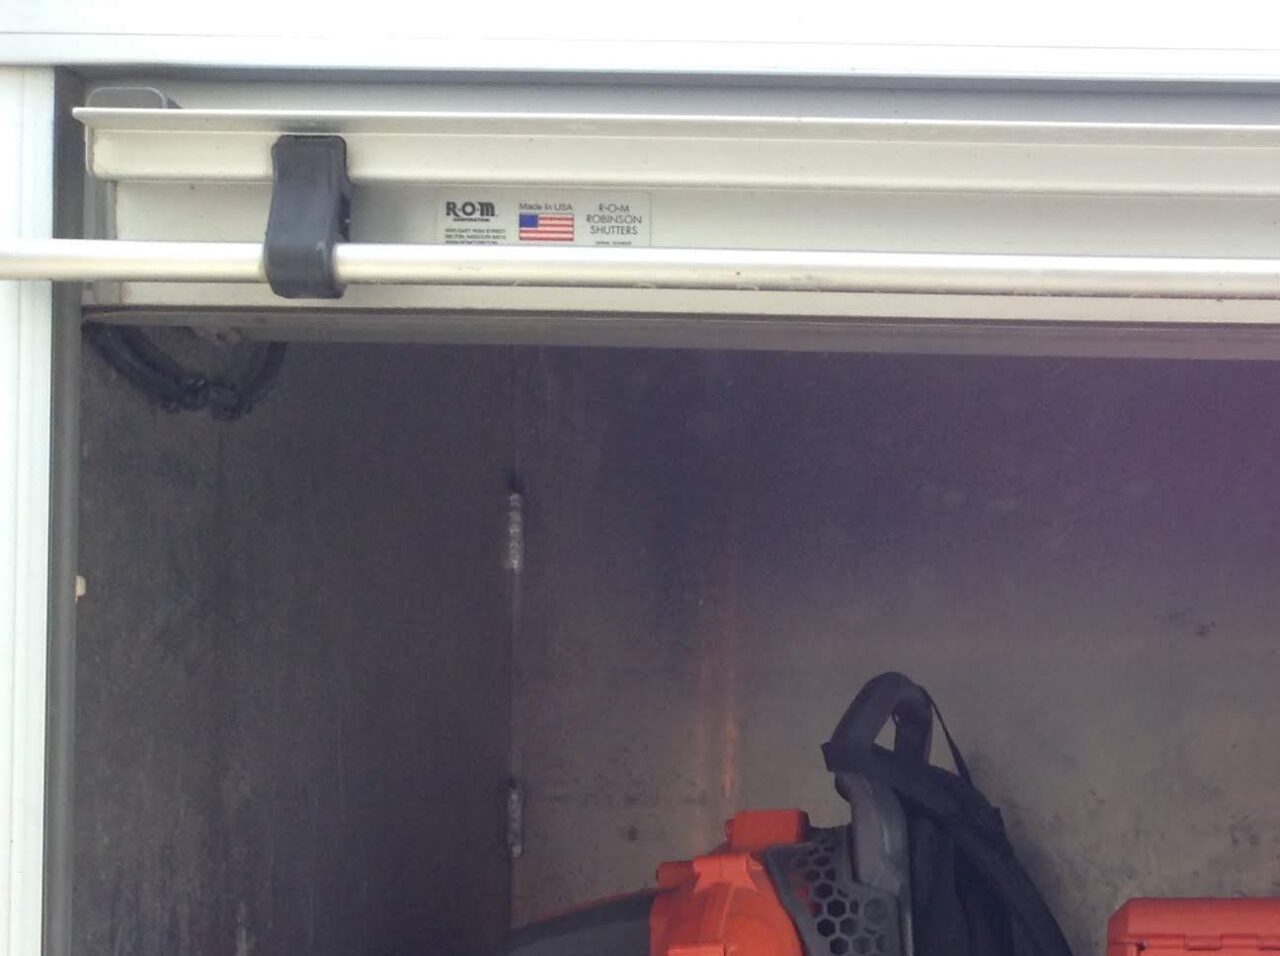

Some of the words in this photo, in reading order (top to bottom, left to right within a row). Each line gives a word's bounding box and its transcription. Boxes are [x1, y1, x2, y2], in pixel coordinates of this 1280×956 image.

[554, 203, 574, 211] USA
[586, 214, 642, 224] ROBINSON
[590, 225, 639, 235] SHUTTERS
